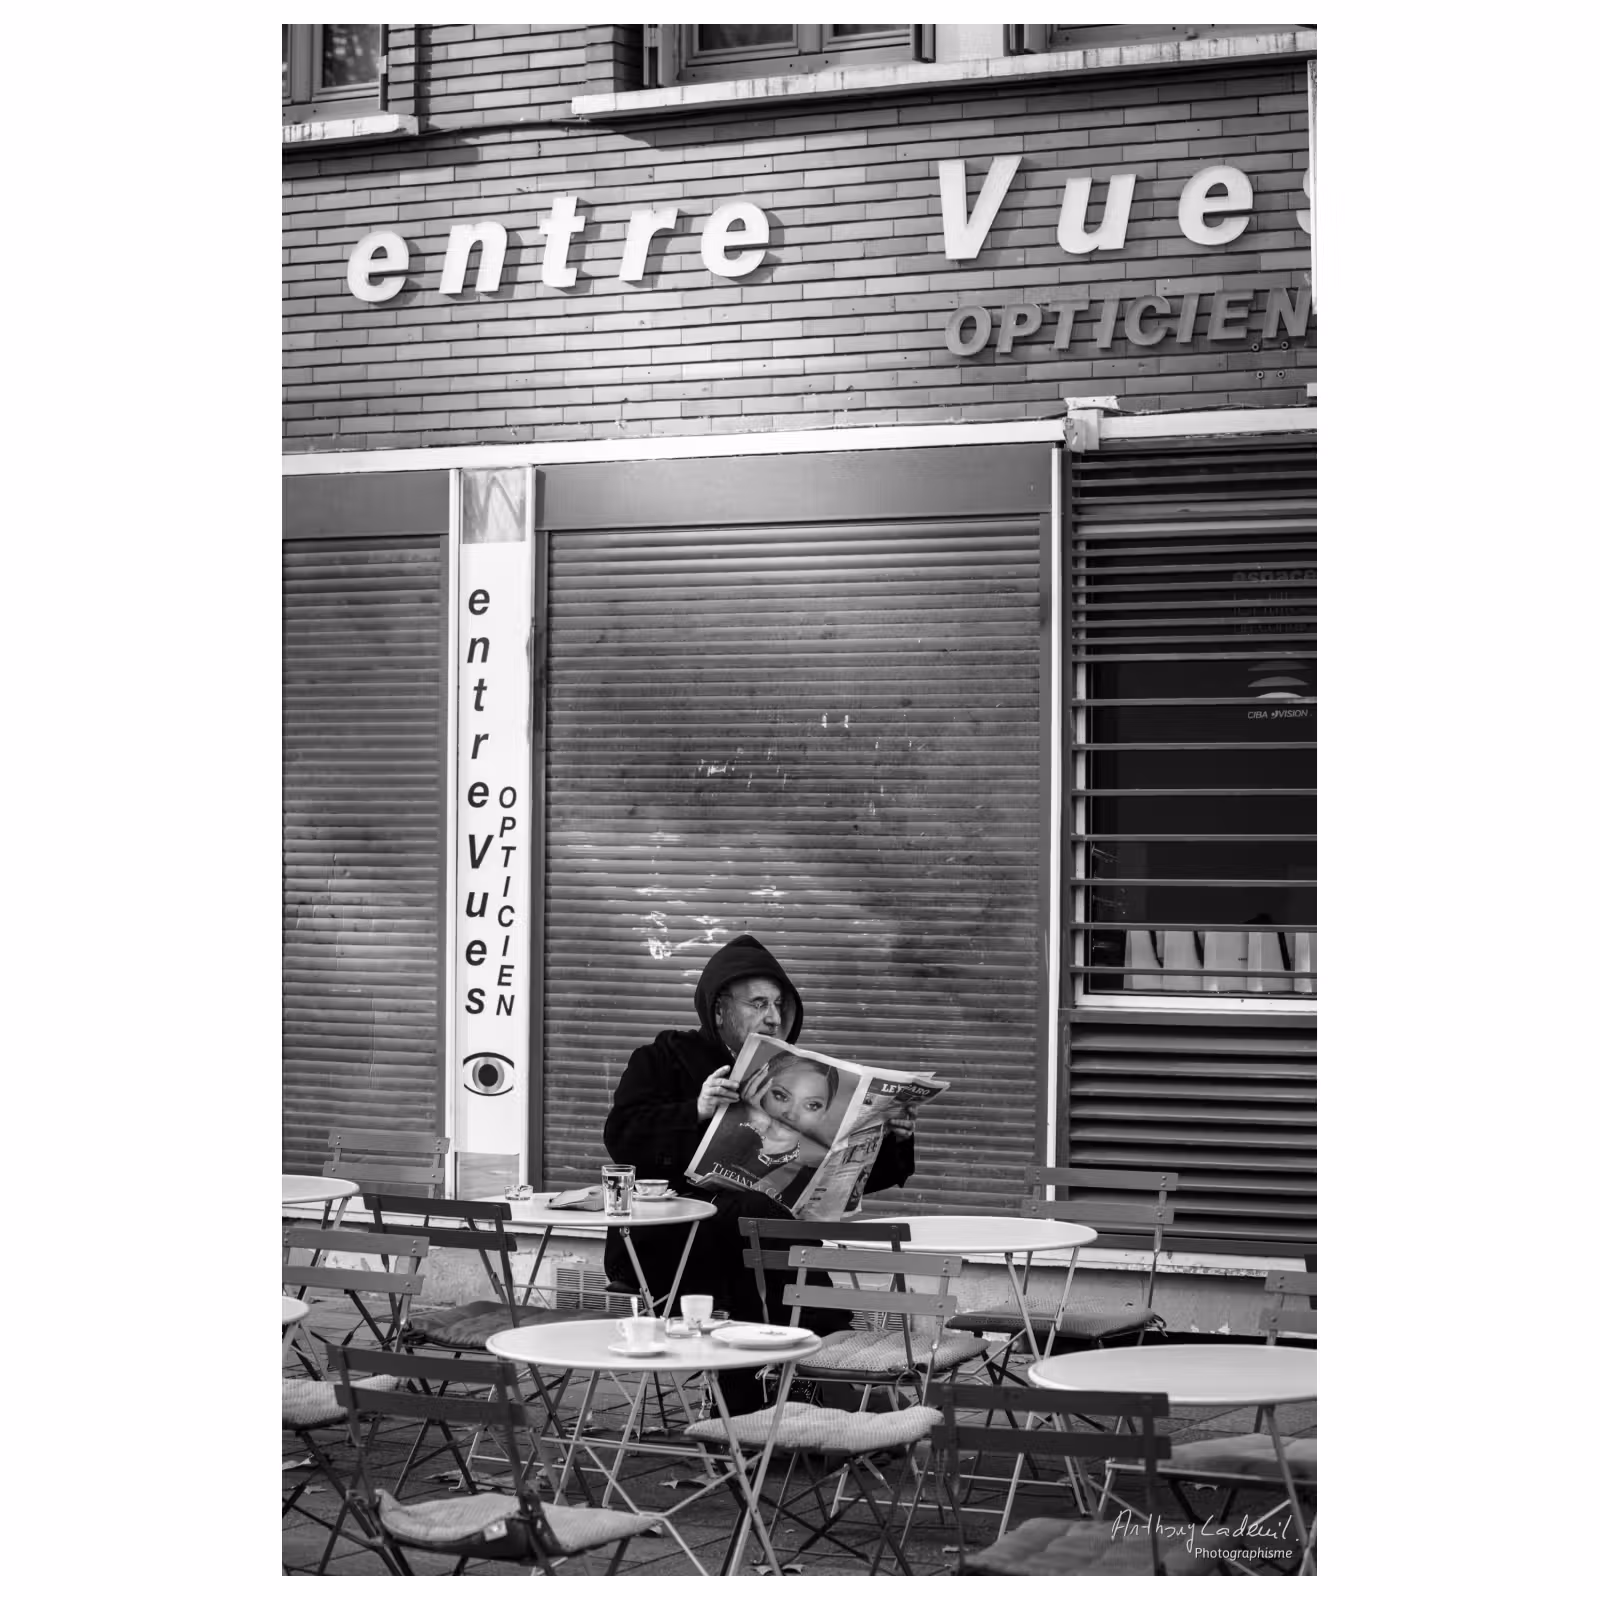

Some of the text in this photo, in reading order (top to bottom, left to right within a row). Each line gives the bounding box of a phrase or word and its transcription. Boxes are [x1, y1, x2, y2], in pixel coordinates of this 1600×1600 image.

[347, 196, 770, 303] entre
[944, 286, 1312, 357] OPTICIEN
[1248, 711, 1268, 719] CIBA
[496, 786, 517, 1016] OPTICIEN
